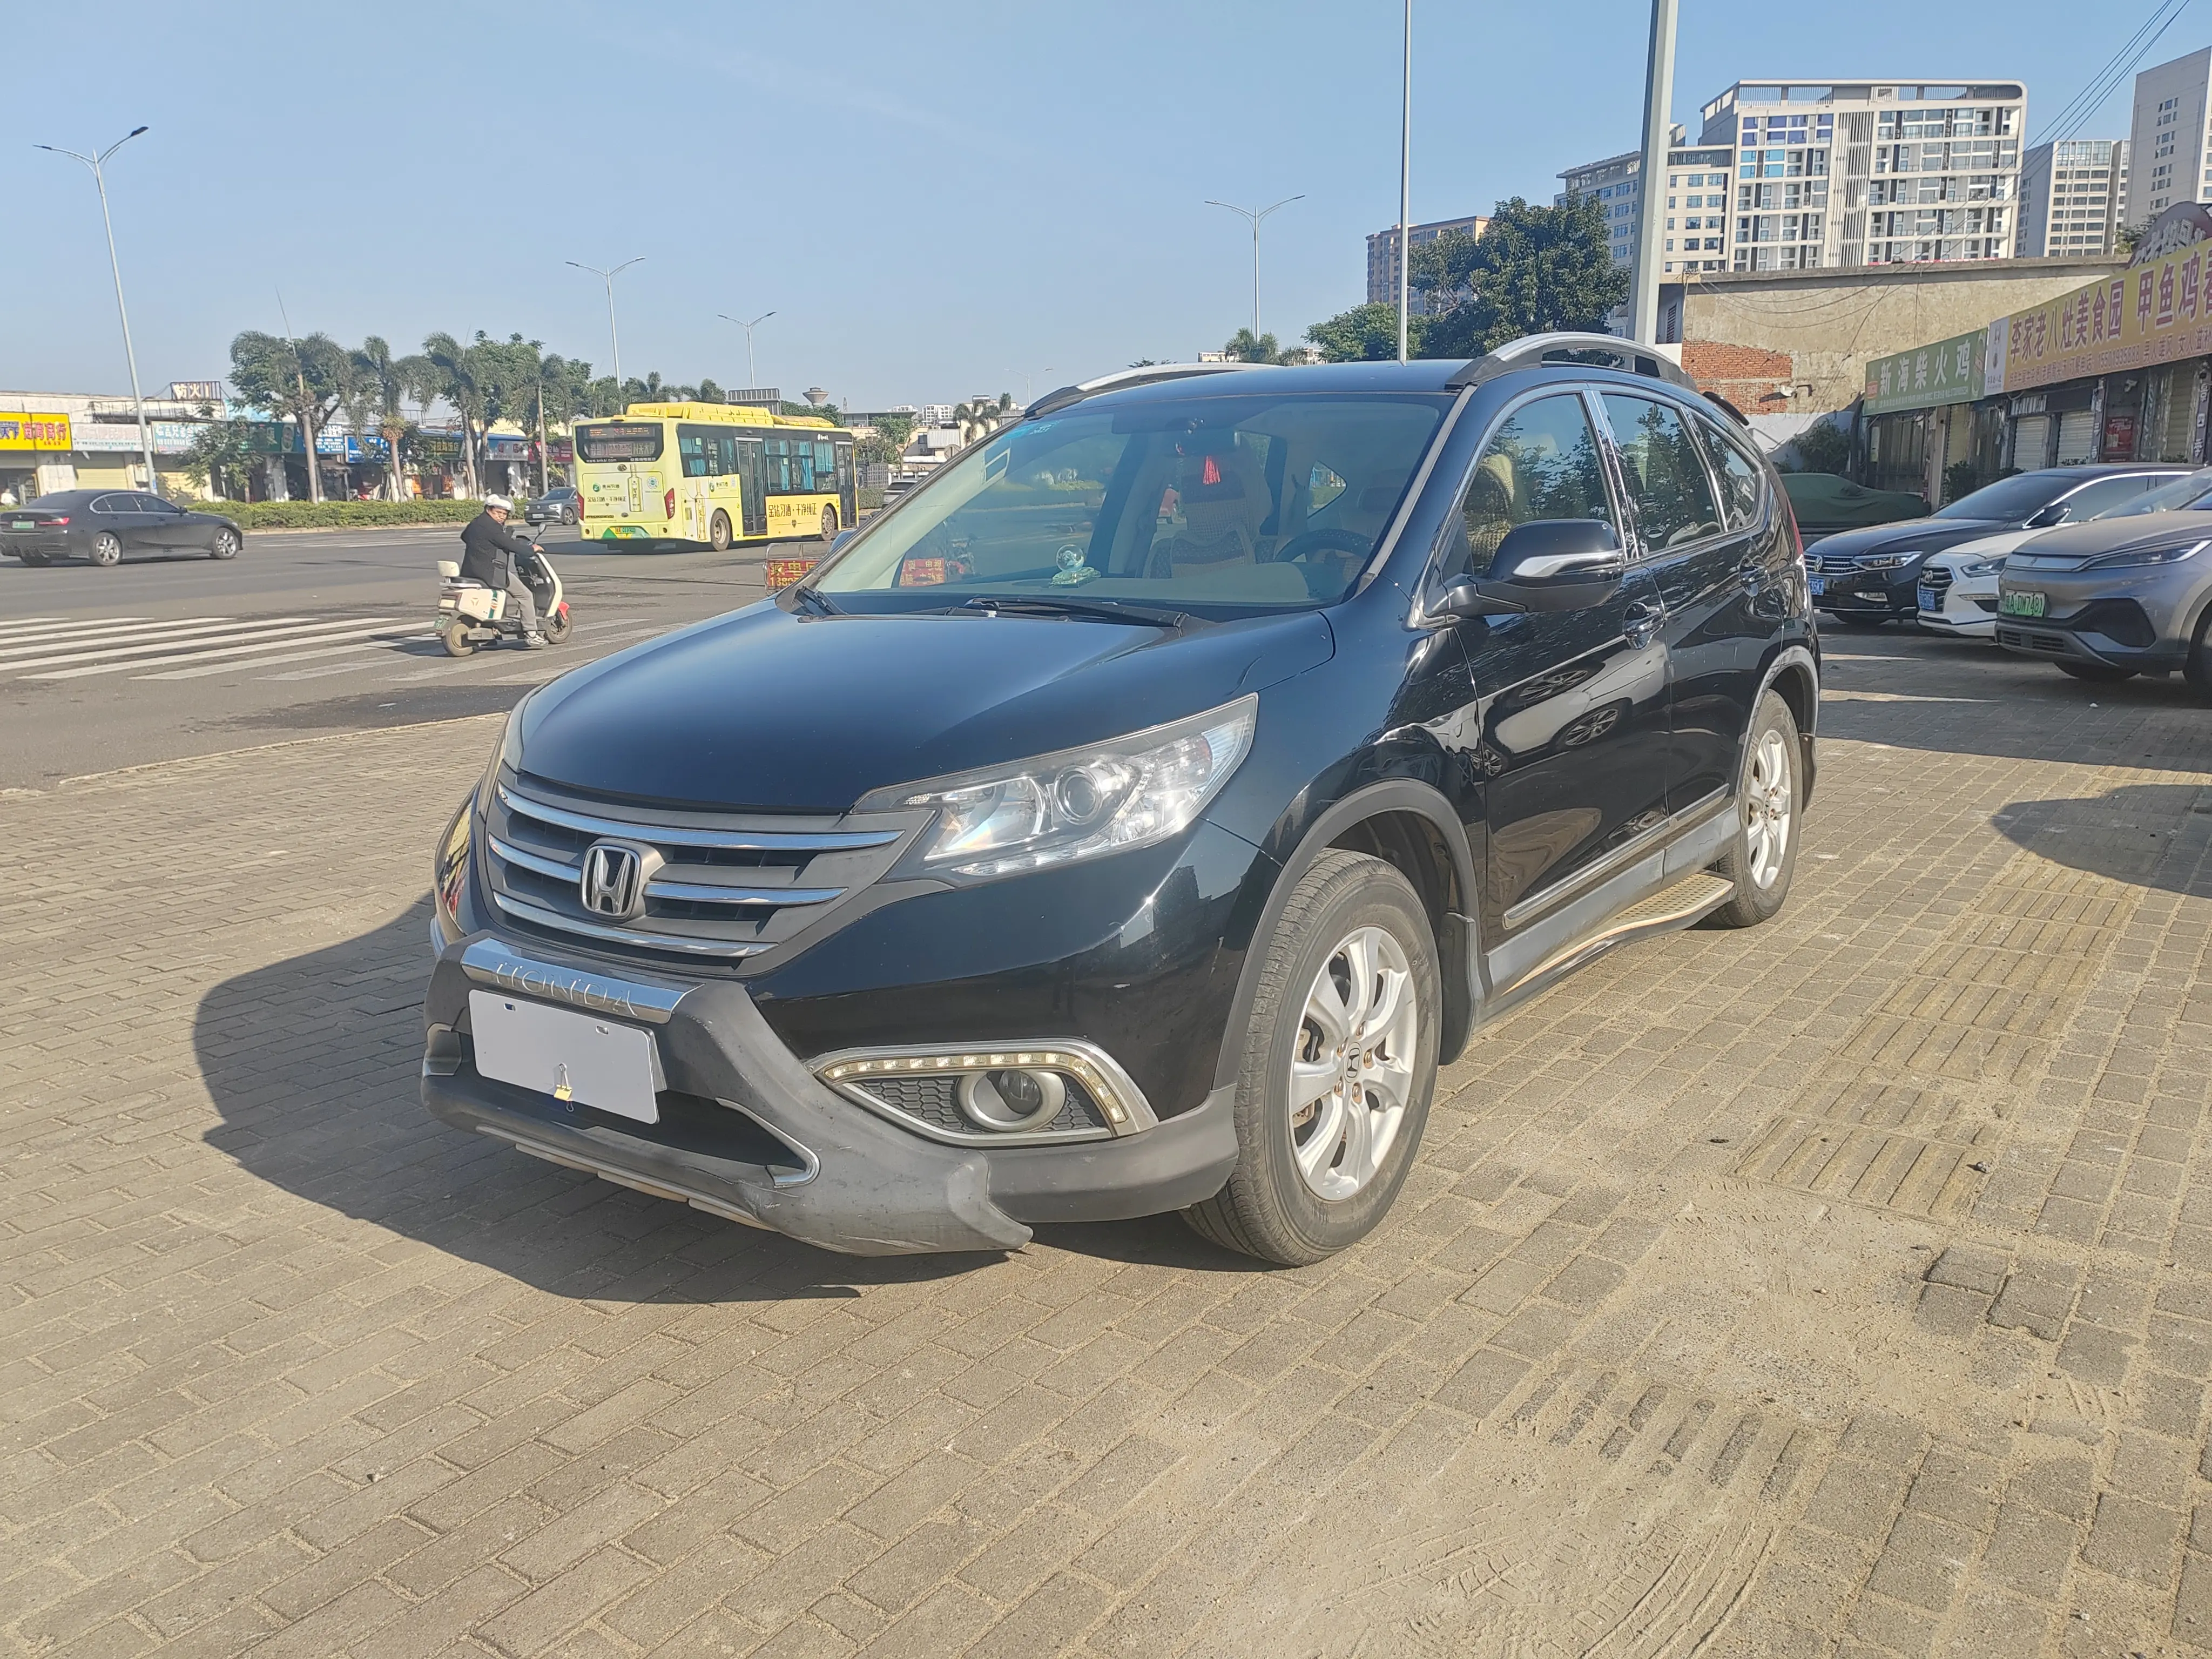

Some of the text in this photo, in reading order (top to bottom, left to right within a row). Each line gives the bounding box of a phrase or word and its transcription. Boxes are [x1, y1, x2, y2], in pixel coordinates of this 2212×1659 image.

[2010, 279, 2125, 365] 李家老八灶美食园
[1879, 339, 1971, 396] 新海柴火鸡
[495, 960, 639, 1017] HONDA
